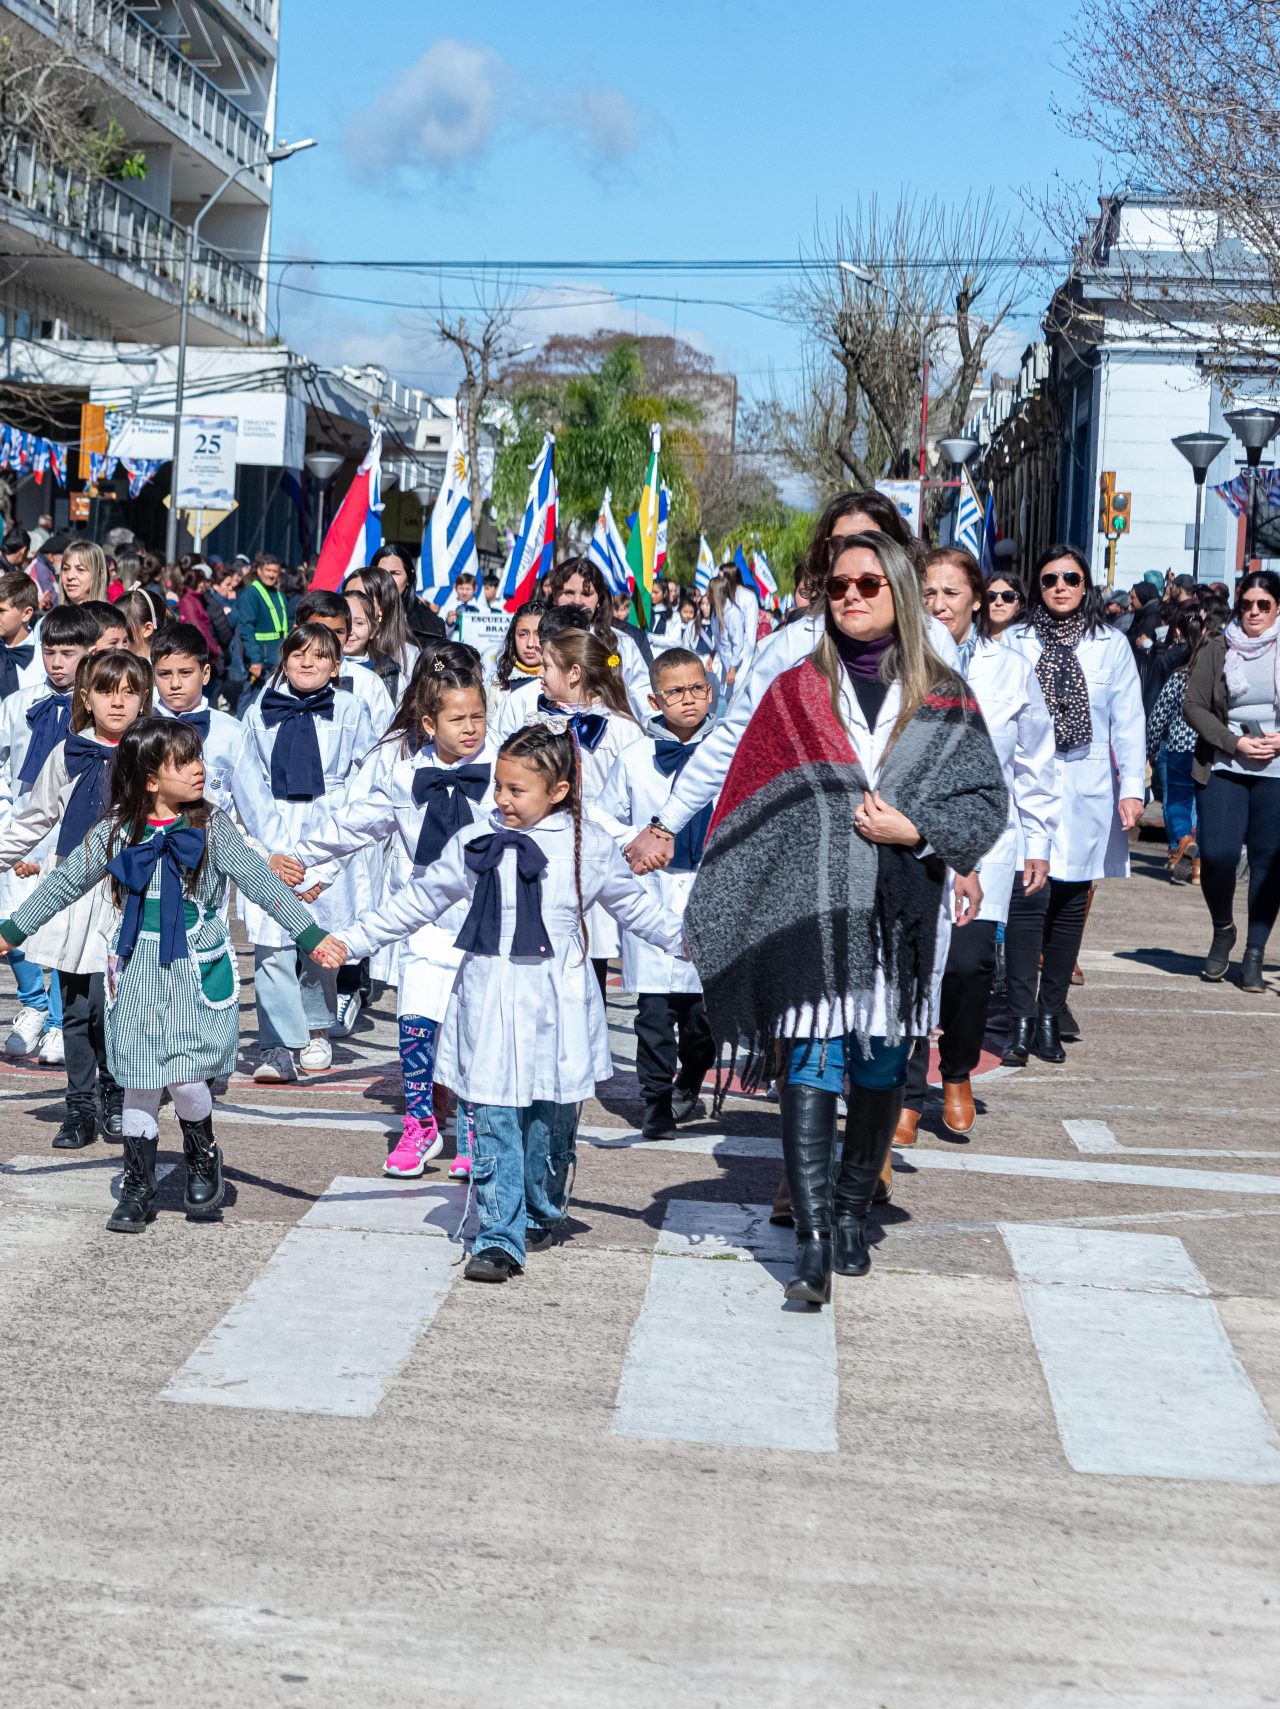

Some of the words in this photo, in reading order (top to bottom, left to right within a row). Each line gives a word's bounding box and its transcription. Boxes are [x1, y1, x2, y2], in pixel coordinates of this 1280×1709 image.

[195, 433, 222, 455] 25
[471, 616, 511, 624] ESCUELA
[401, 1022, 433, 1039] LUCKY
